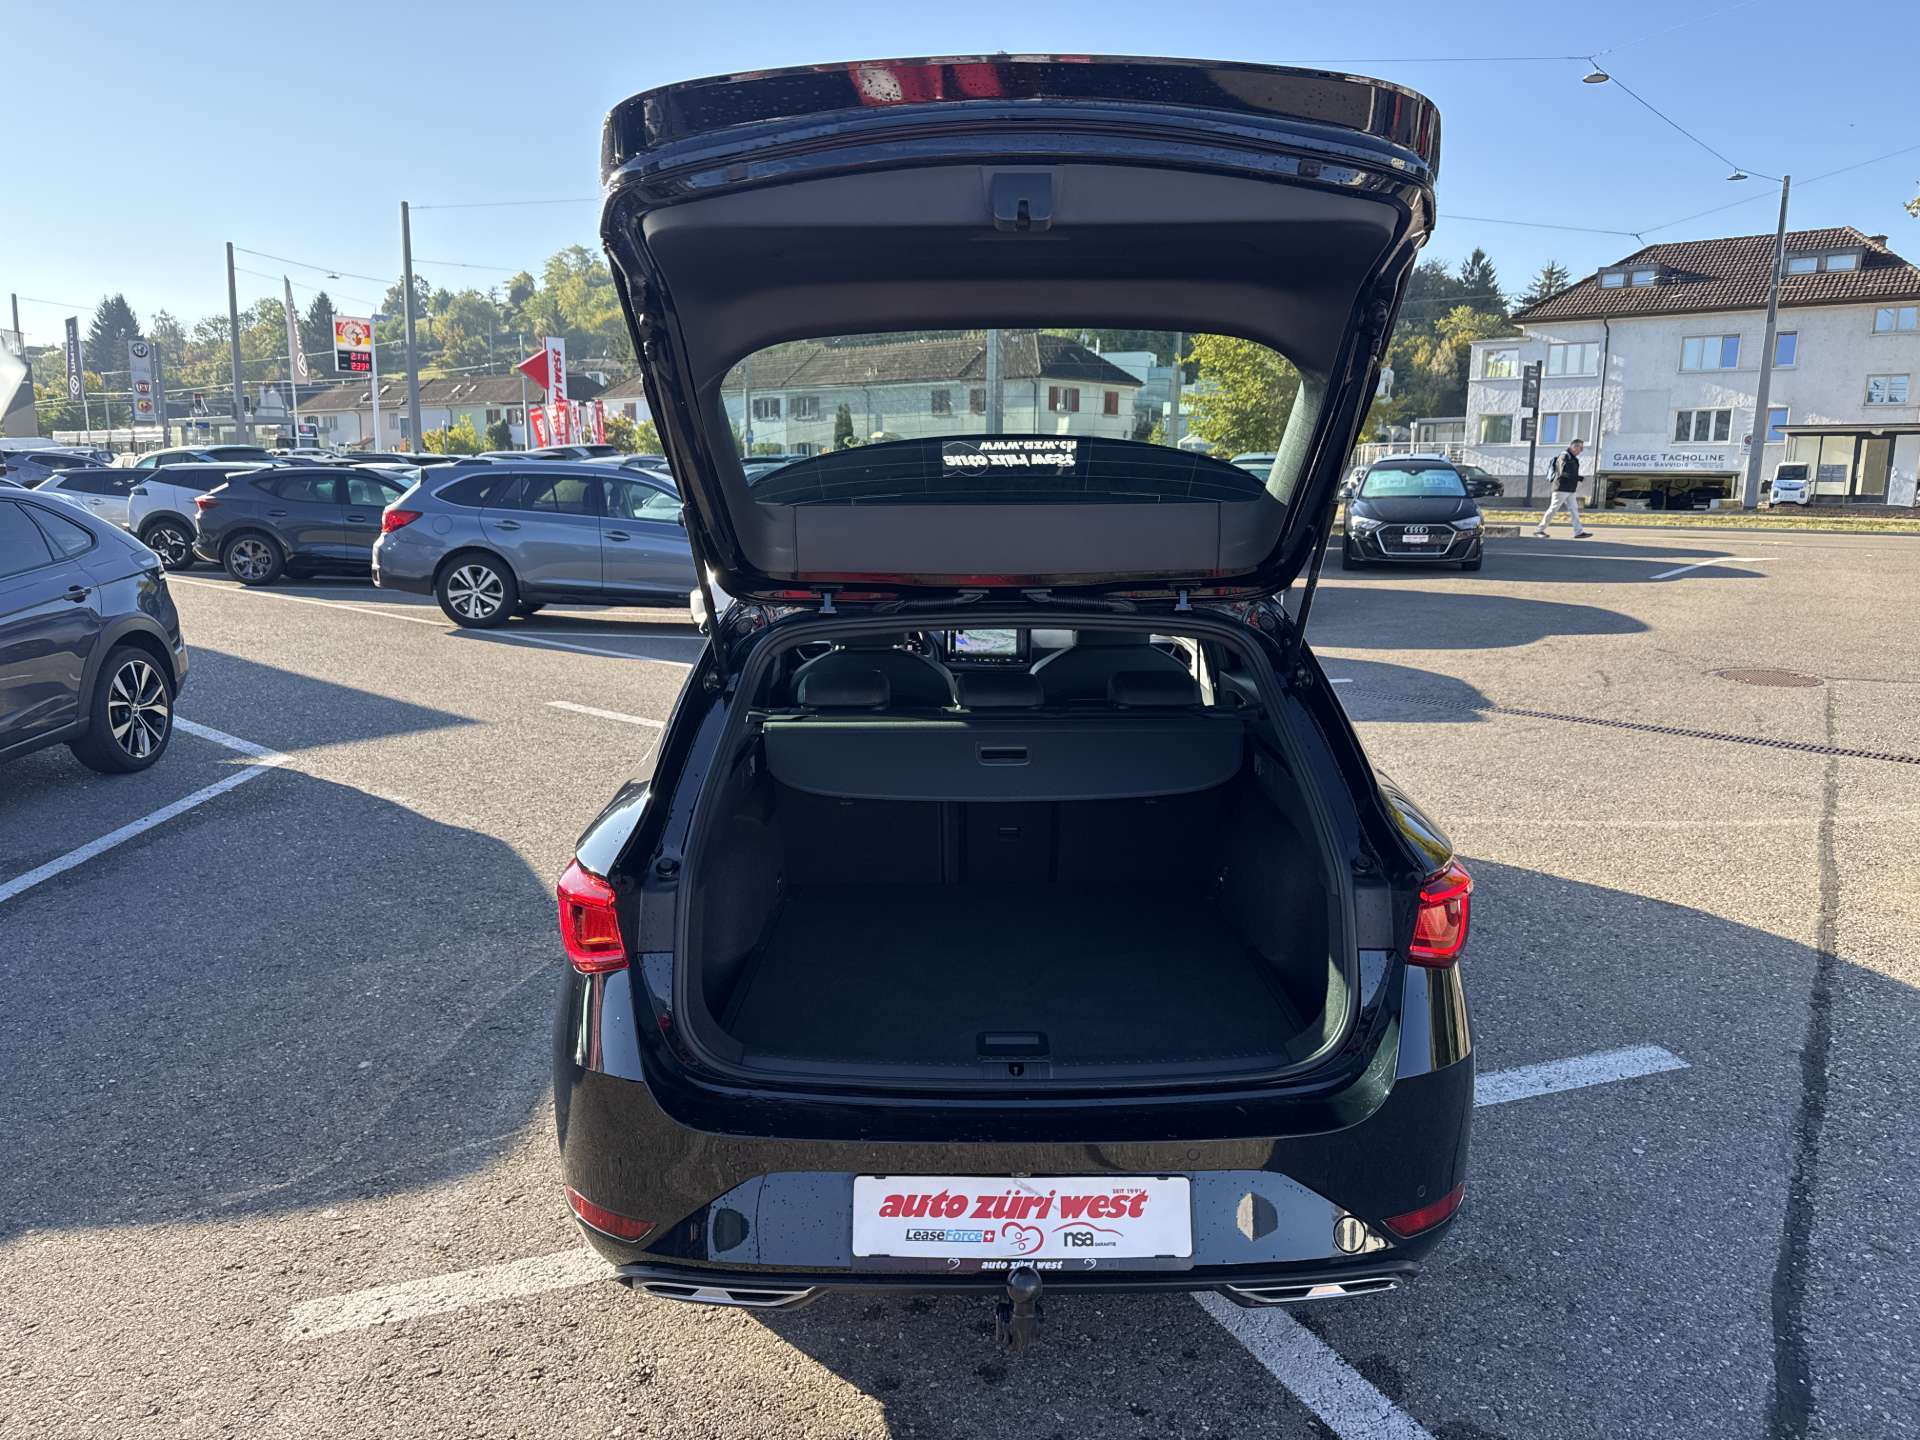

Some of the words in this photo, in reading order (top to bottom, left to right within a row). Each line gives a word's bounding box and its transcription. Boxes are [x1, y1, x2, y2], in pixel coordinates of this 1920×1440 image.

[1613, 453, 1657, 461] GARAGE
[1660, 453, 1726, 461] TACHOLINE
[878, 1188, 970, 1219] auto
[968, 1189, 1057, 1220] züri
[1060, 1189, 1149, 1219] west
[905, 1228, 983, 1243] LeaseForce
[1063, 1231, 1095, 1248] nsa
[981, 1260, 1008, 1270] auto
[1009, 1259, 1035, 1270] züri
[1036, 1260, 1064, 1270] west
